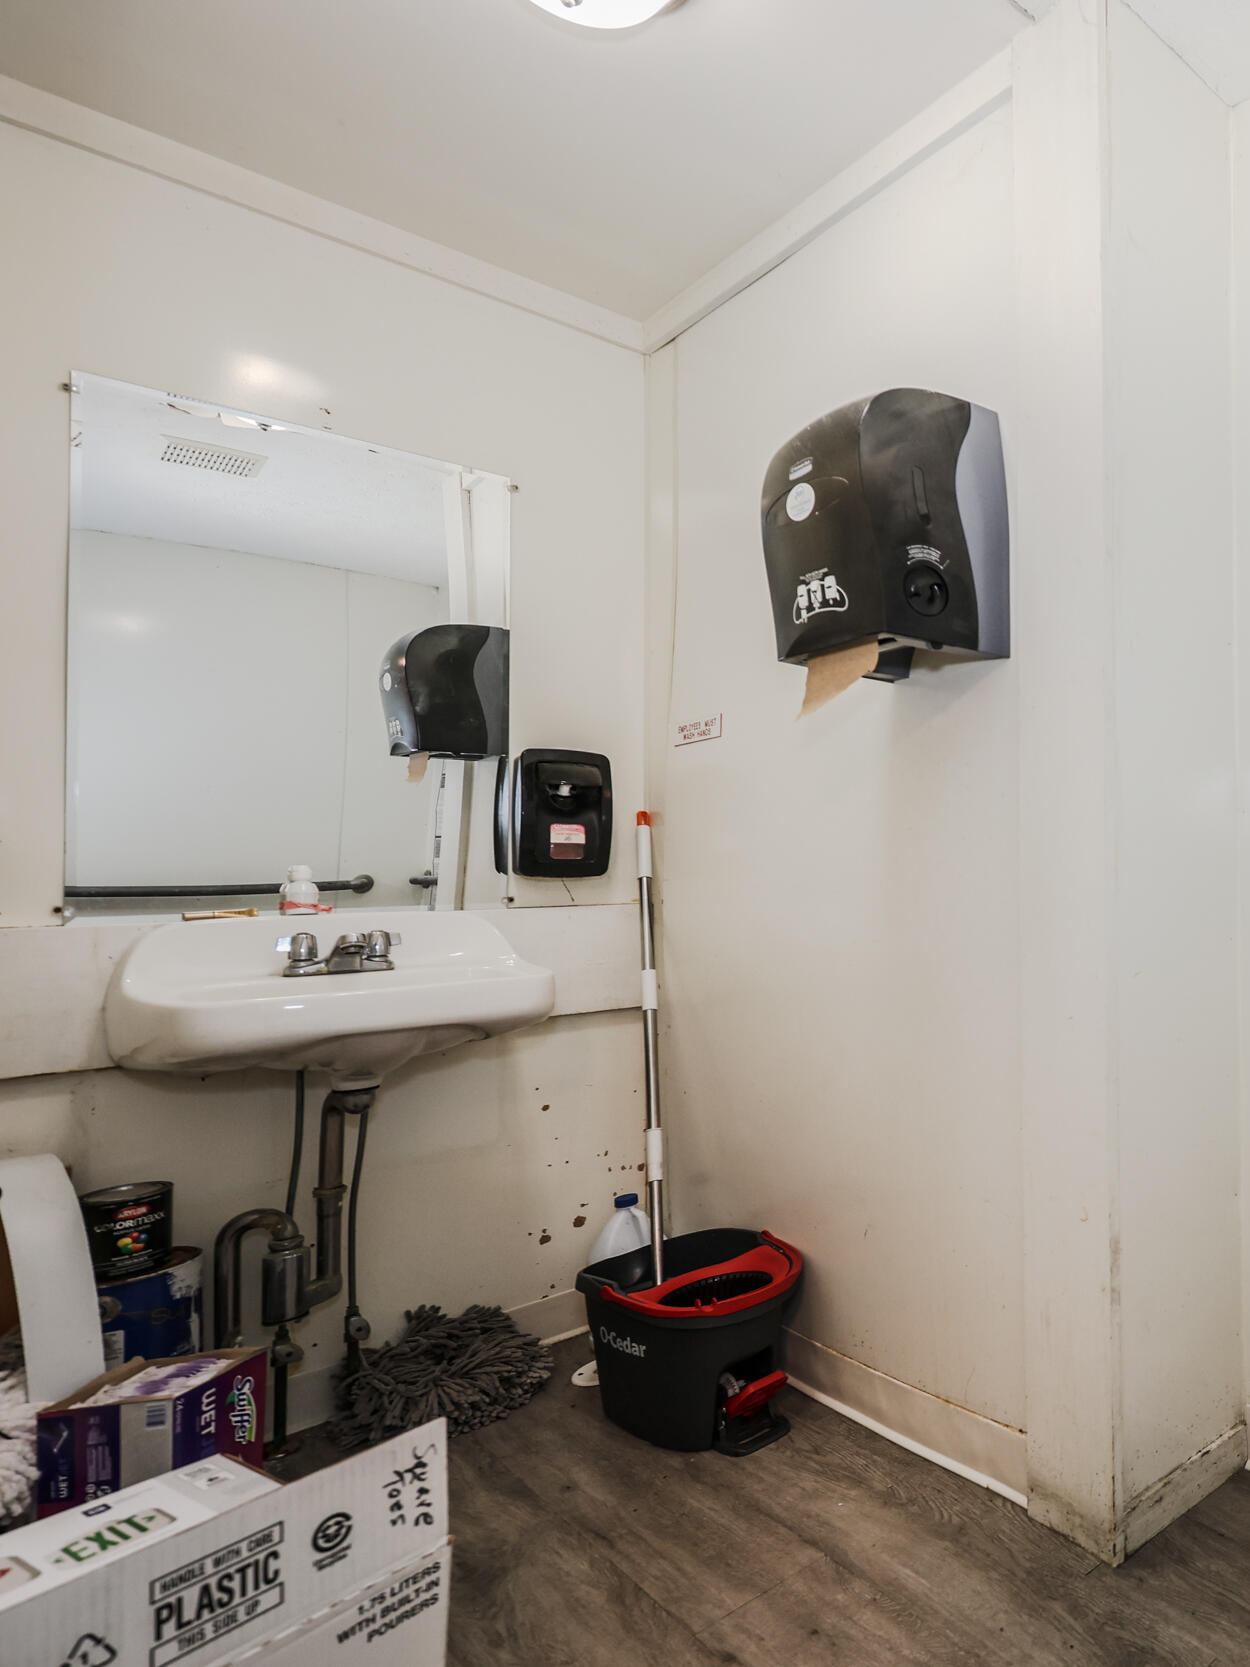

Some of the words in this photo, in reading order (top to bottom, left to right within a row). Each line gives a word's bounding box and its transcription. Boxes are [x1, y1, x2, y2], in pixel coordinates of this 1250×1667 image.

[683, 731, 695, 741] WASH
[696, 727, 712, 738] HANDS
[704, 717, 717, 728] MUST
[600, 1326, 647, 1358] O-Cedar
[229, 1376, 255, 1443] Swiffer
[61, 1514, 150, 1562] EXIT
[159, 1563, 206, 1592] HANDLE
[211, 1546, 242, 1569] WITH
[246, 1529, 275, 1552] CARE
[153, 1550, 281, 1642] PLASTIC
[336, 1613, 376, 1645] WITH
[379, 1577, 441, 1619] BUILT-IN
[357, 1591, 386, 1616] 1.75
[389, 1562, 441, 1598] LITERS
[176, 1629, 207, 1651] THIS
[211, 1609, 240, 1632] SIDE
[244, 1599, 261, 1617] UP
[366, 1593, 440, 1644] POURERS
